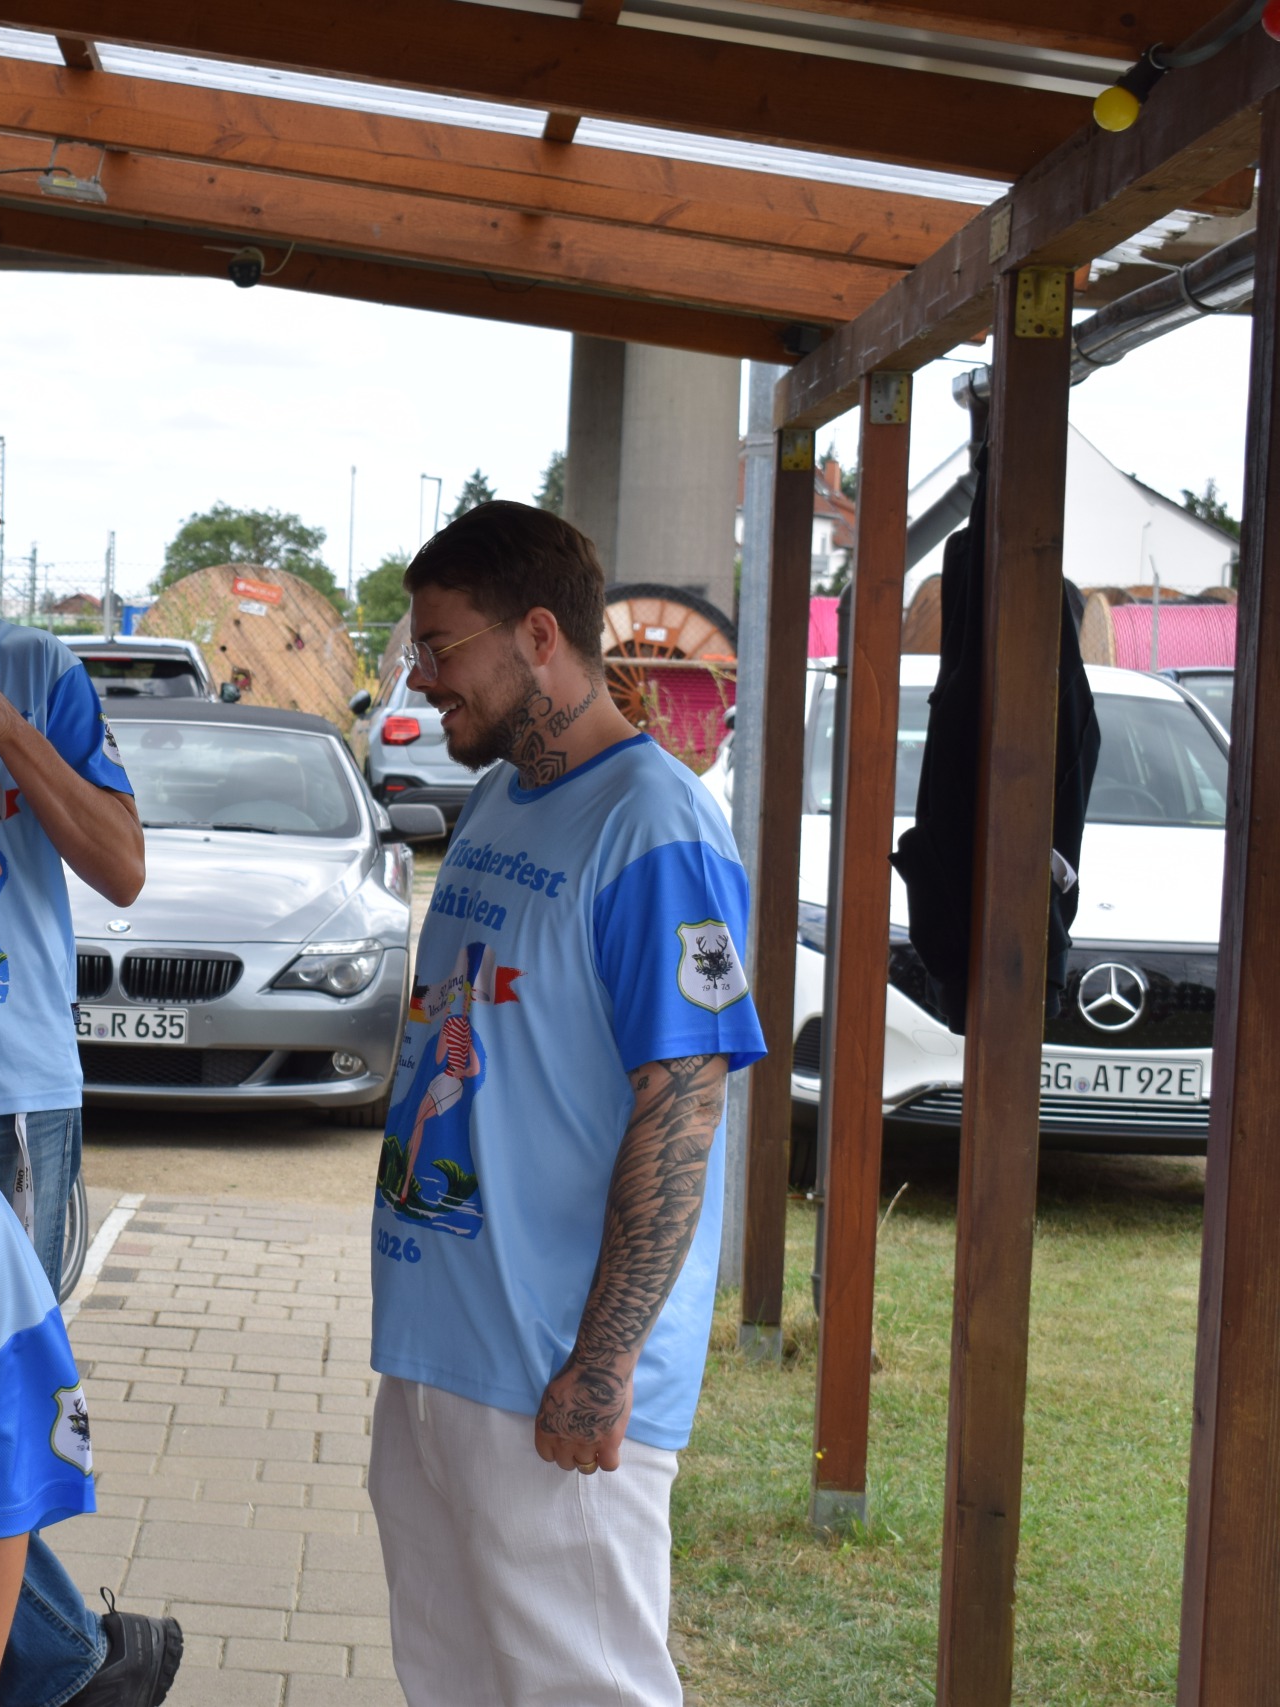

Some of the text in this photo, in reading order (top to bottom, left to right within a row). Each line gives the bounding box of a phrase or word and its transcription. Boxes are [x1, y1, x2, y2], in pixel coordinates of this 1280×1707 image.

[546, 678, 599, 738] Blessed
[445, 838, 568, 899] Fischerfest
[111, 1013, 127, 1038] R
[135, 1013, 185, 1039] 635
[376, 1227, 422, 1264] 2026
